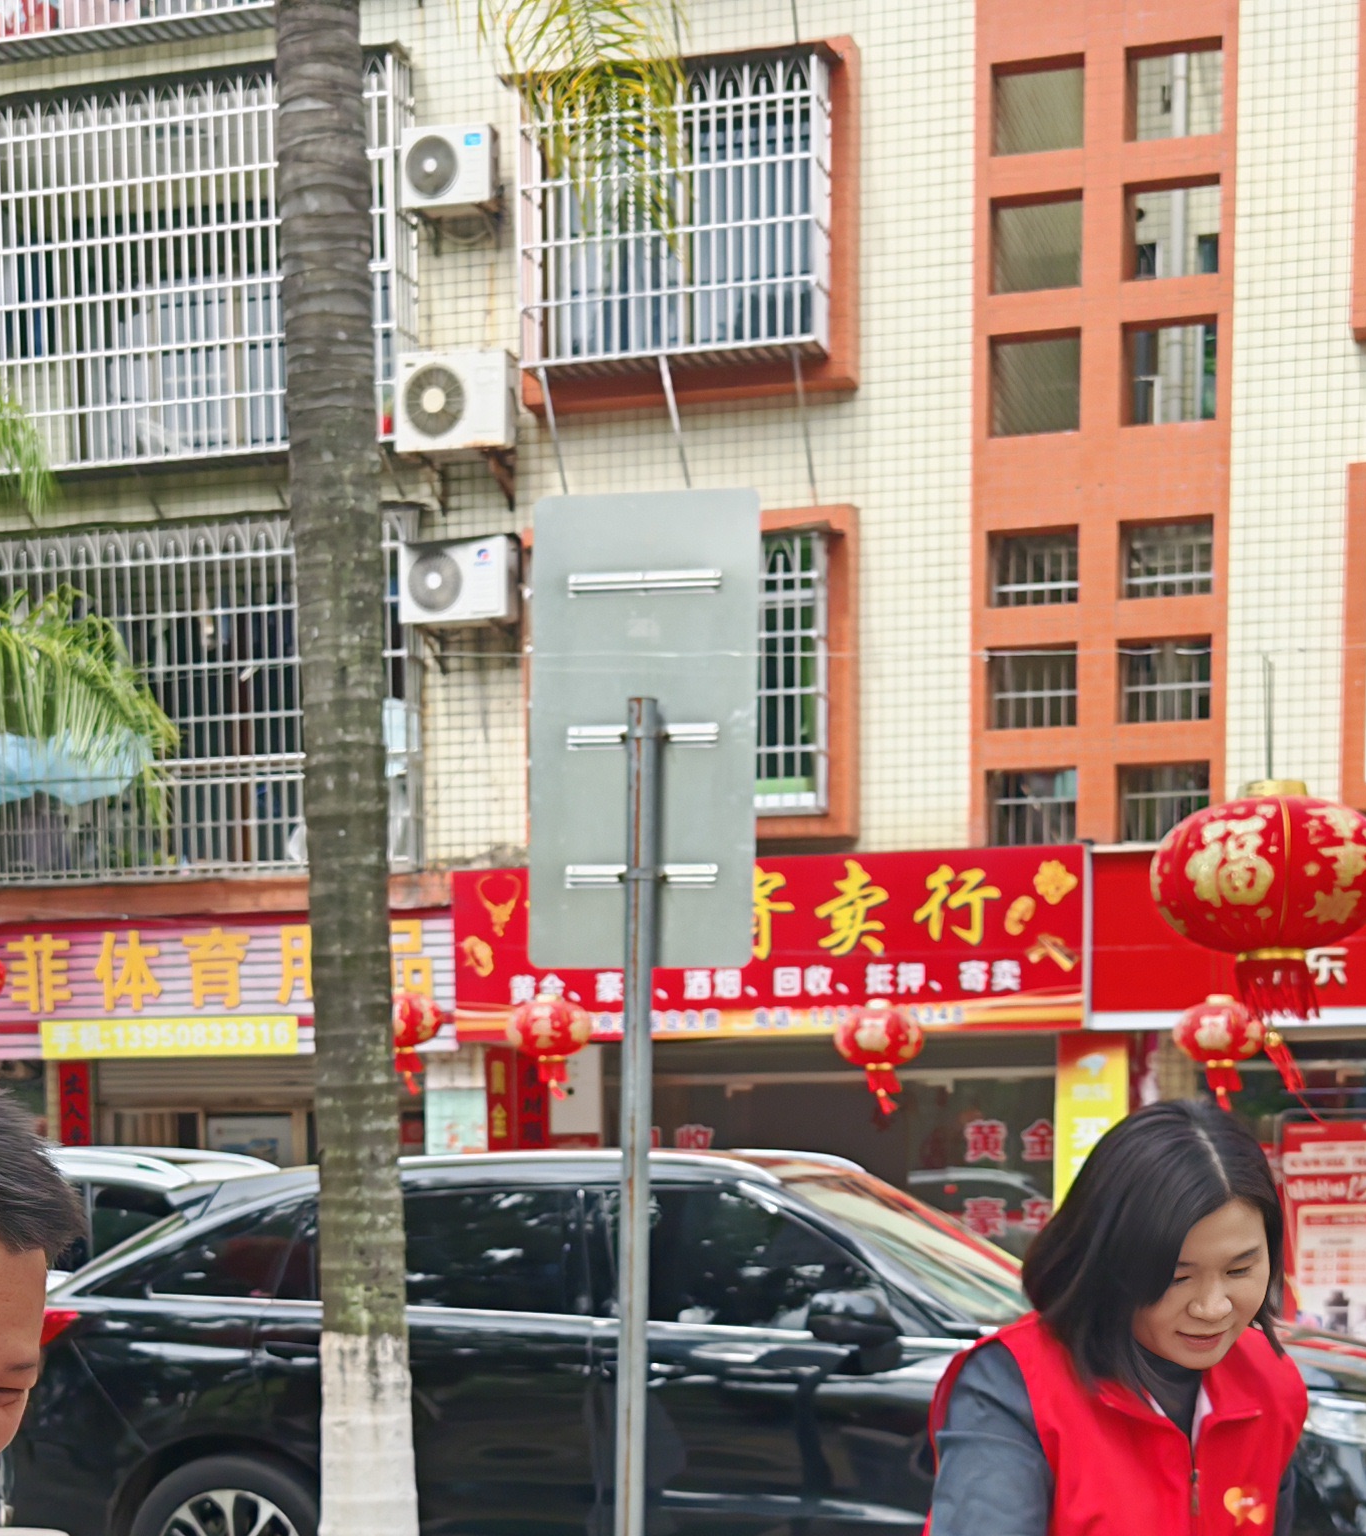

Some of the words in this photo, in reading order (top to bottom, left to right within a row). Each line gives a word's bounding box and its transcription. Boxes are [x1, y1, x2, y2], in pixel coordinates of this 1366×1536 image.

[510, 958, 1023, 1003] 黄金、豪、酒烟、回收、抵押、寄卖
[965, 1119, 1053, 1163] 黄金
